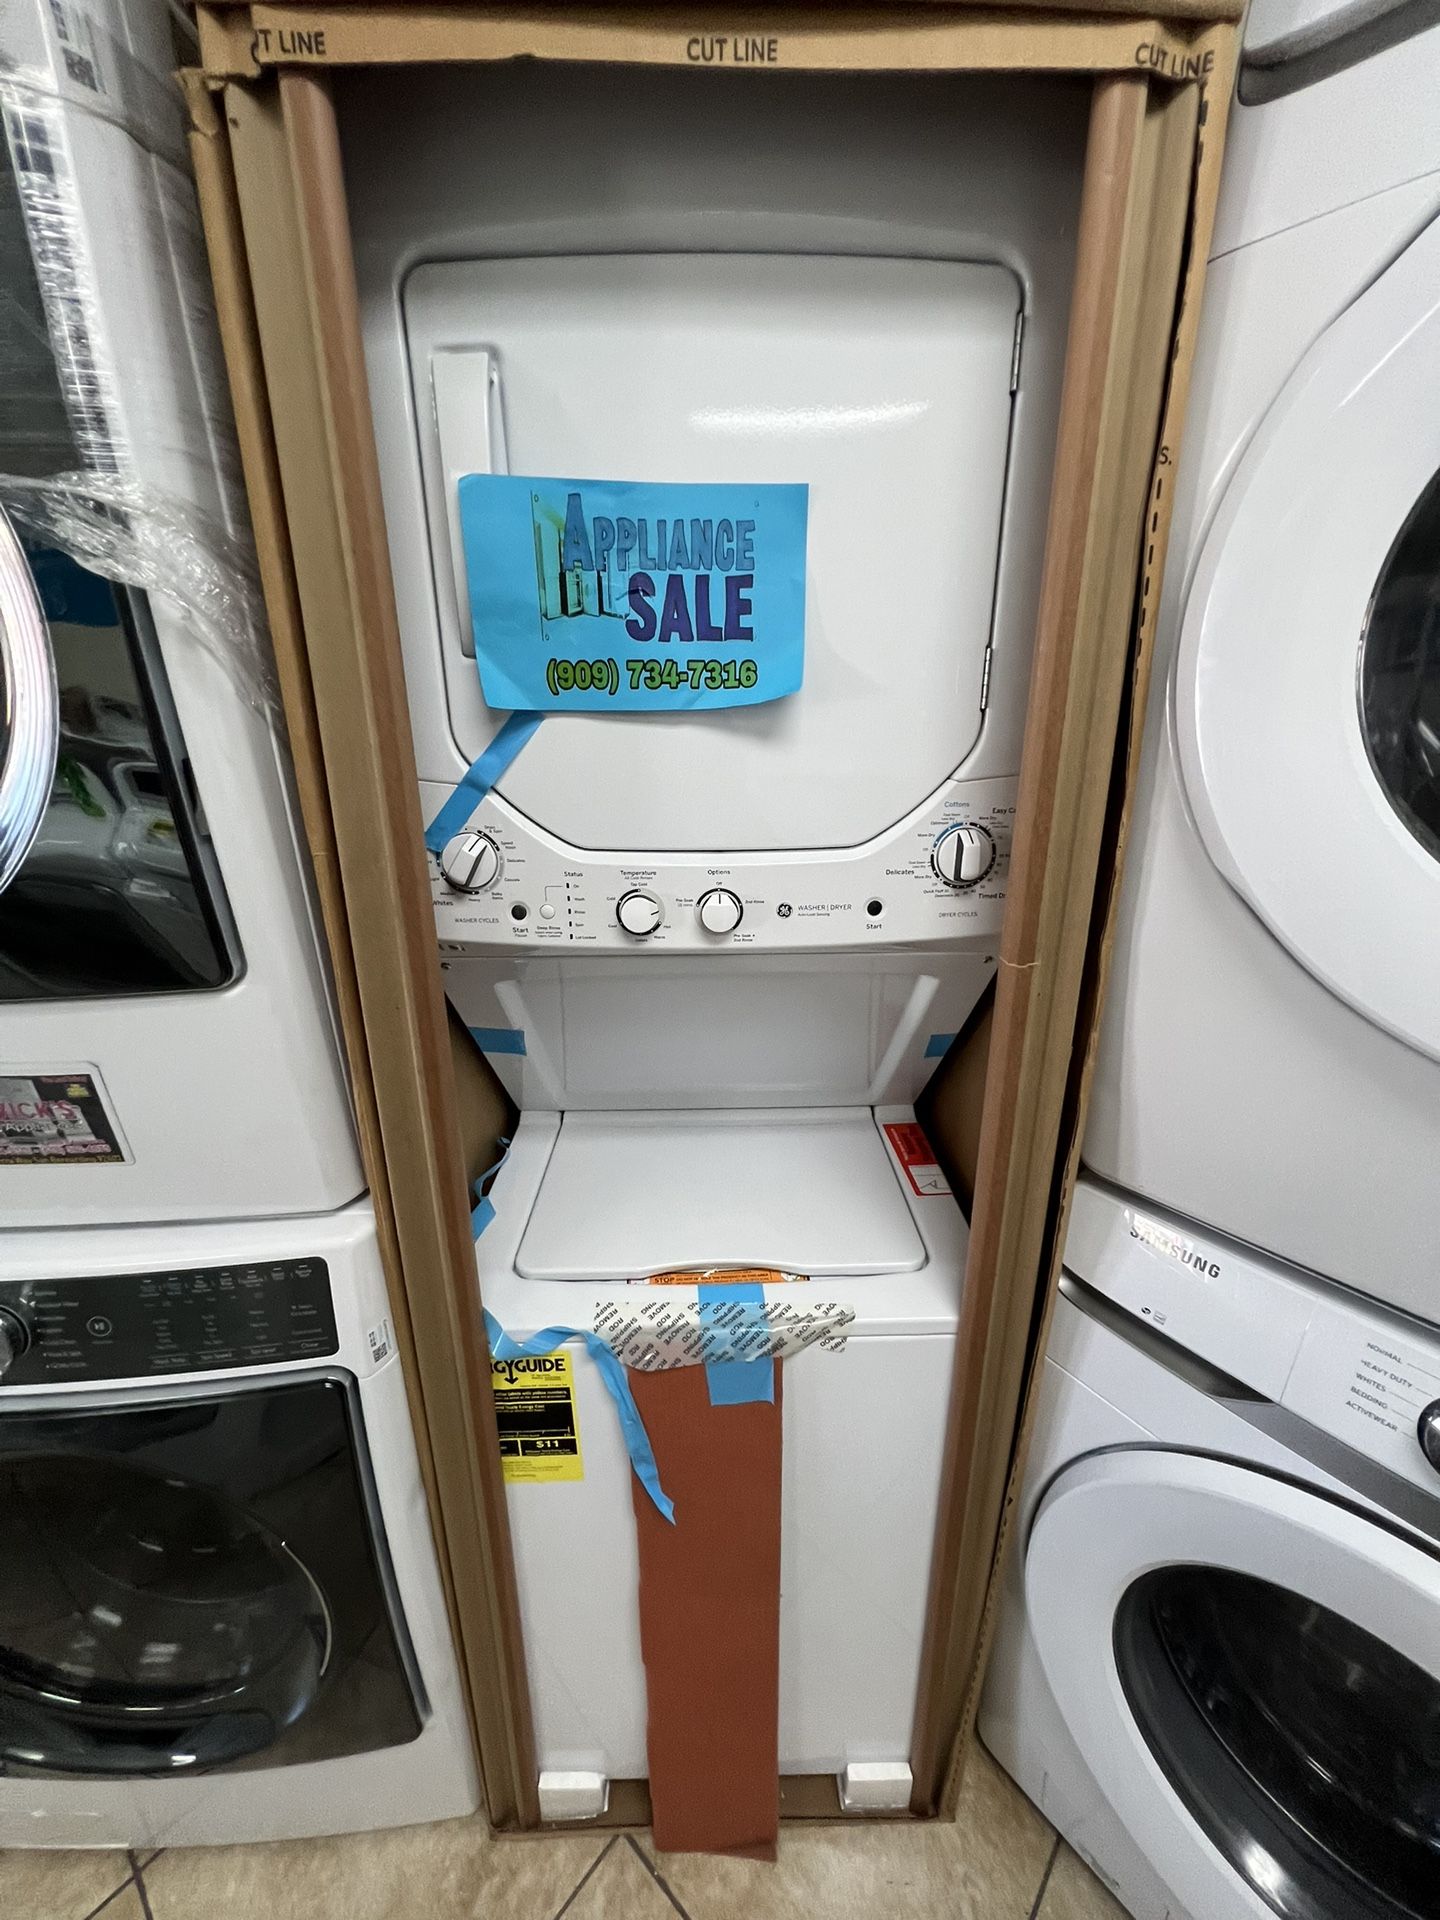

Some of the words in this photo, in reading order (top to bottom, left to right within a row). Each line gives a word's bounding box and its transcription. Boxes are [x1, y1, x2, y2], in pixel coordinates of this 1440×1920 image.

[279, 30, 326, 55] LINE
[687, 37, 727, 61] CUT
[734, 38, 778, 62] LINE
[1135, 42, 1168, 70] CUT
[1171, 50, 1215, 78] LINE
[564, 493, 756, 572] APPLIANCE
[626, 572, 754, 642] SALE
[547, 658, 619, 695] (909)
[626, 660, 757, 691] 734-7316
[992, 807, 1007, 815] Easy
[1130, 1225, 1221, 1279] SSUNG
[656, 1313, 671, 1328] ROD
[656, 1312, 685, 1339] SHIPPING
[664, 1320, 690, 1345] REMOVE
[682, 1328, 697, 1343] ROD
[1367, 1342, 1402, 1364] NORMAL
[490, 1357, 567, 1375] GYGUIDE
[1361, 1359, 1389, 1376] HEAVY
[1390, 1373, 1413, 1388] DUTY
[1356, 1372, 1387, 1392] WHITES
[1350, 1386, 1388, 1409] BEDDING
[1345, 1400, 1398, 1431] ACTIVEWEAR
